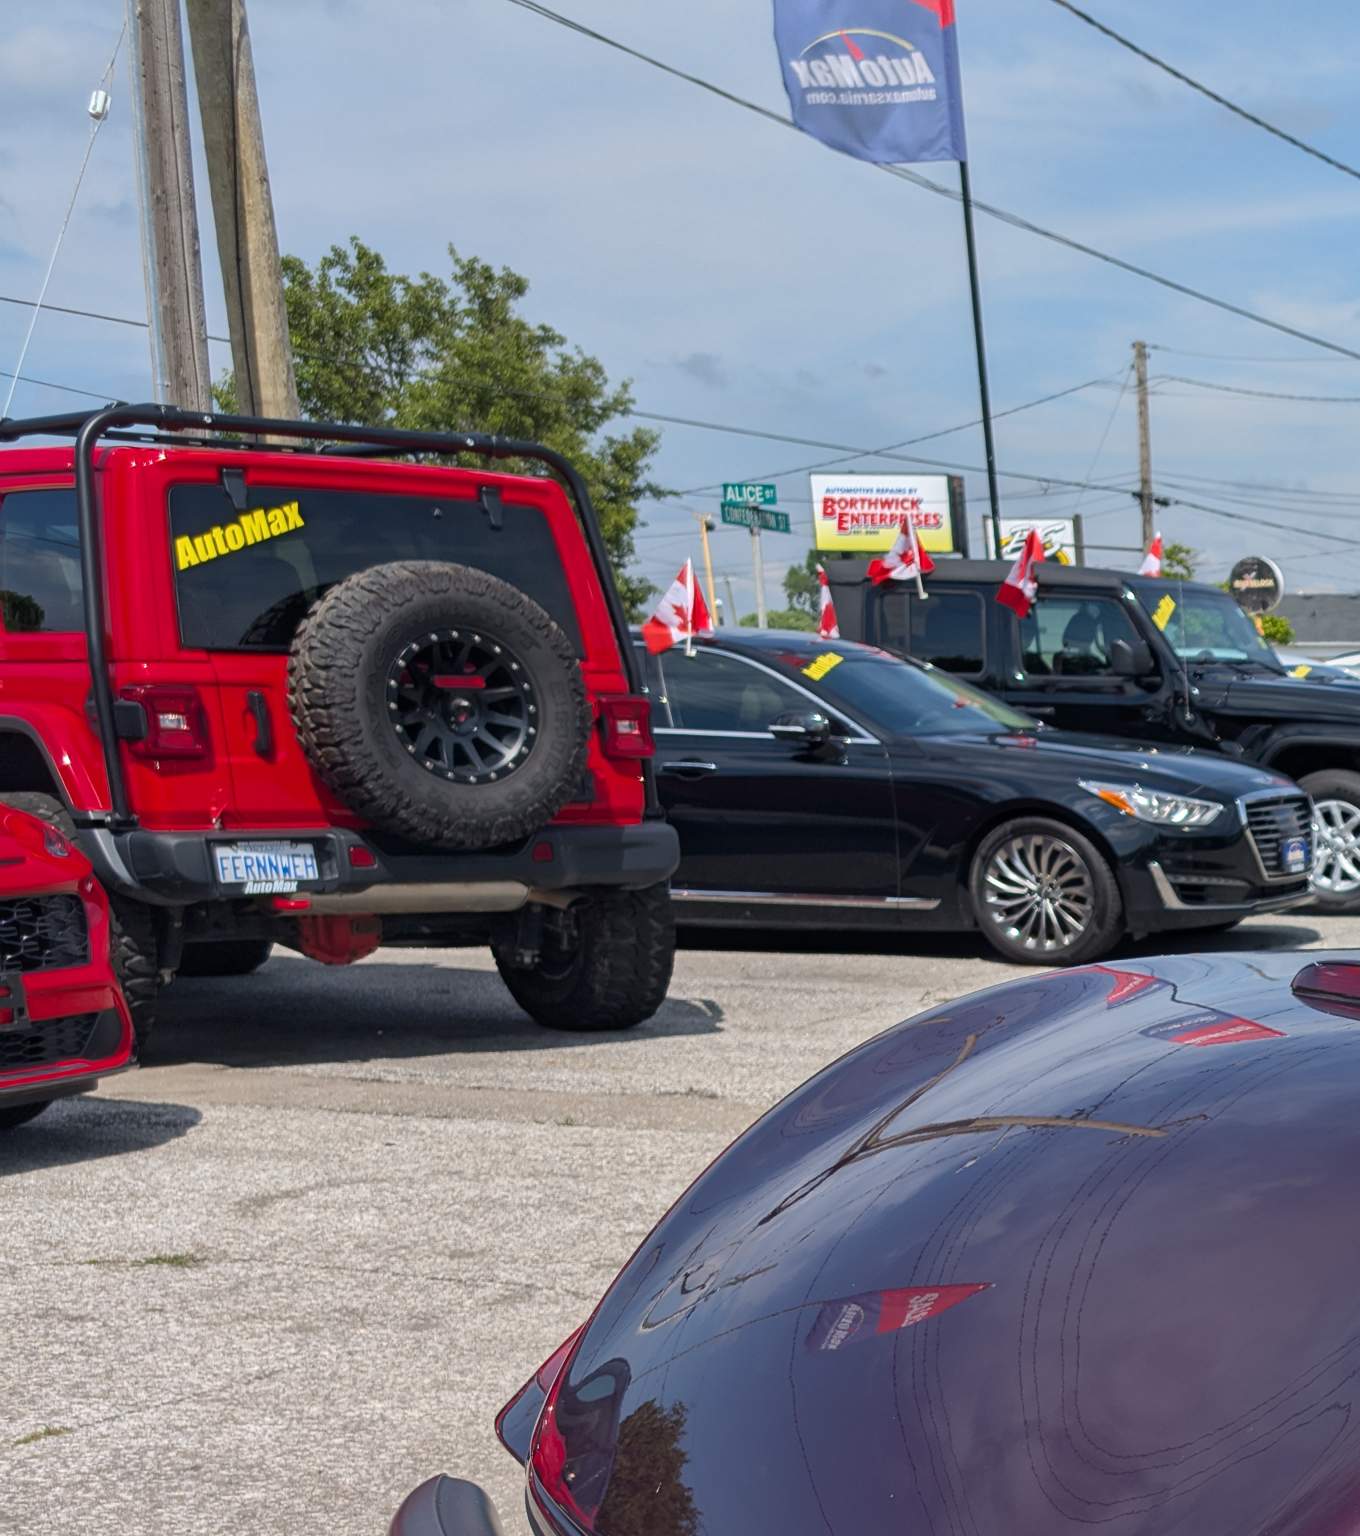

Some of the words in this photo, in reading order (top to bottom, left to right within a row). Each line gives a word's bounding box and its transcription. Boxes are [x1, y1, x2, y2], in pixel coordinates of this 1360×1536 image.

[726, 485, 765, 502] ALICE
[765, 488, 775, 499] ST
[823, 497, 923, 519] BORTHWICK
[837, 513, 943, 534] ENTERPRSES
[176, 501, 305, 570] AutoMax
[220, 854, 317, 880] FERNNWEH
[245, 880, 298, 894] AutoMax
